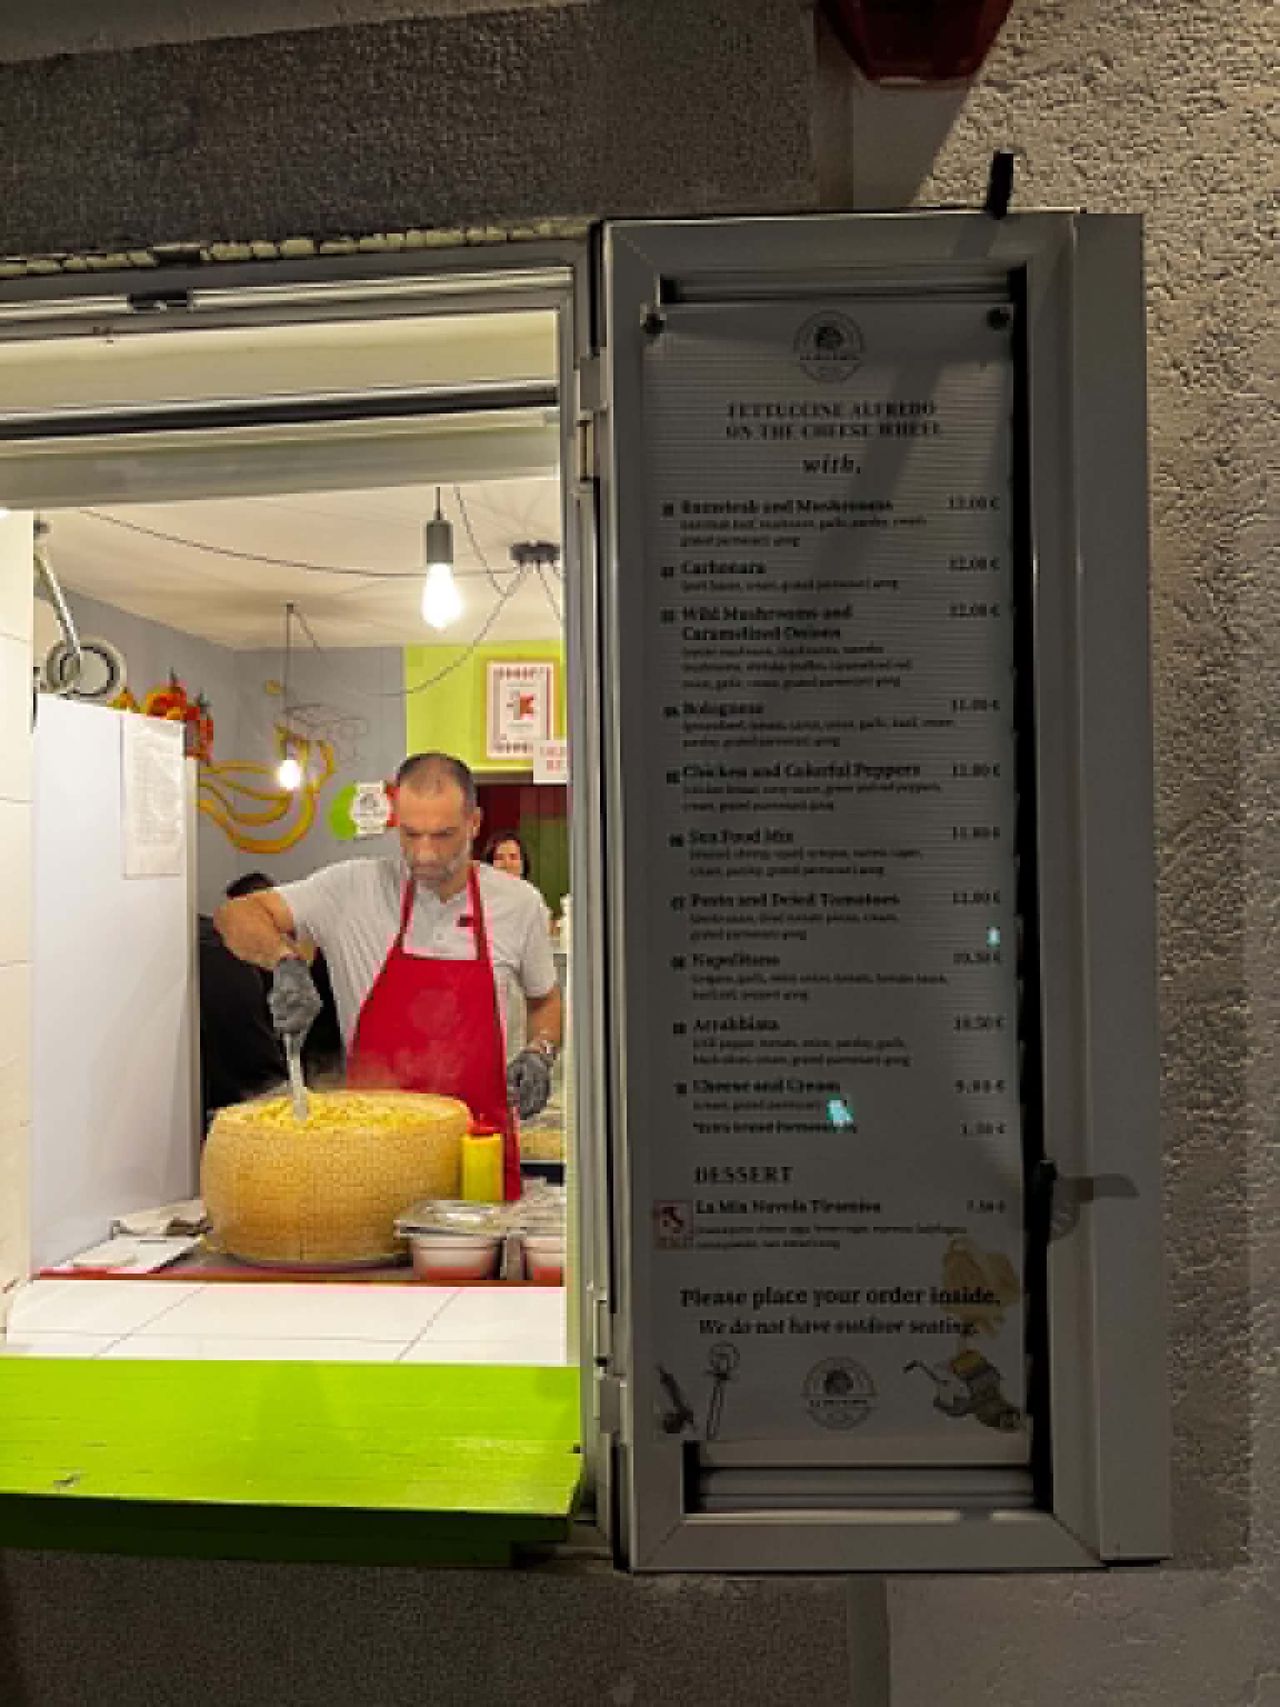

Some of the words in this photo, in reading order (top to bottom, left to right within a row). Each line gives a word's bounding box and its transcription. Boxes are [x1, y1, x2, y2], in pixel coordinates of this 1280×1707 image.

[761, 422, 793, 440] THE
[800, 422, 868, 440] CHEESE
[878, 422, 941, 440] WHEEL
[763, 500, 793, 515] and
[681, 560, 767, 575] Carbonara
[723, 605, 818, 621] Mushrooms
[823, 604, 853, 620] and
[784, 626, 841, 641] Onions
[683, 764, 748, 778] Chicken
[753, 763, 781, 777] and
[854, 761, 920, 780] Peppers
[736, 892, 767, 907] and
[772, 892, 815, 907] Dried
[819, 892, 900, 907] Tomatoes
[753, 1079, 783, 1093] and
[694, 1166, 793, 1184] DESSERT
[696, 1200, 714, 1214] La
[681, 1288, 747, 1308] Please
[752, 1286, 808, 1310] place
[812, 1288, 861, 1309] your
[865, 1286, 925, 1304] order
[699, 1319, 723, 1335] We
[729, 1318, 755, 1335] do
[756, 1319, 786, 1335] not
[789, 1316, 831, 1335] have
